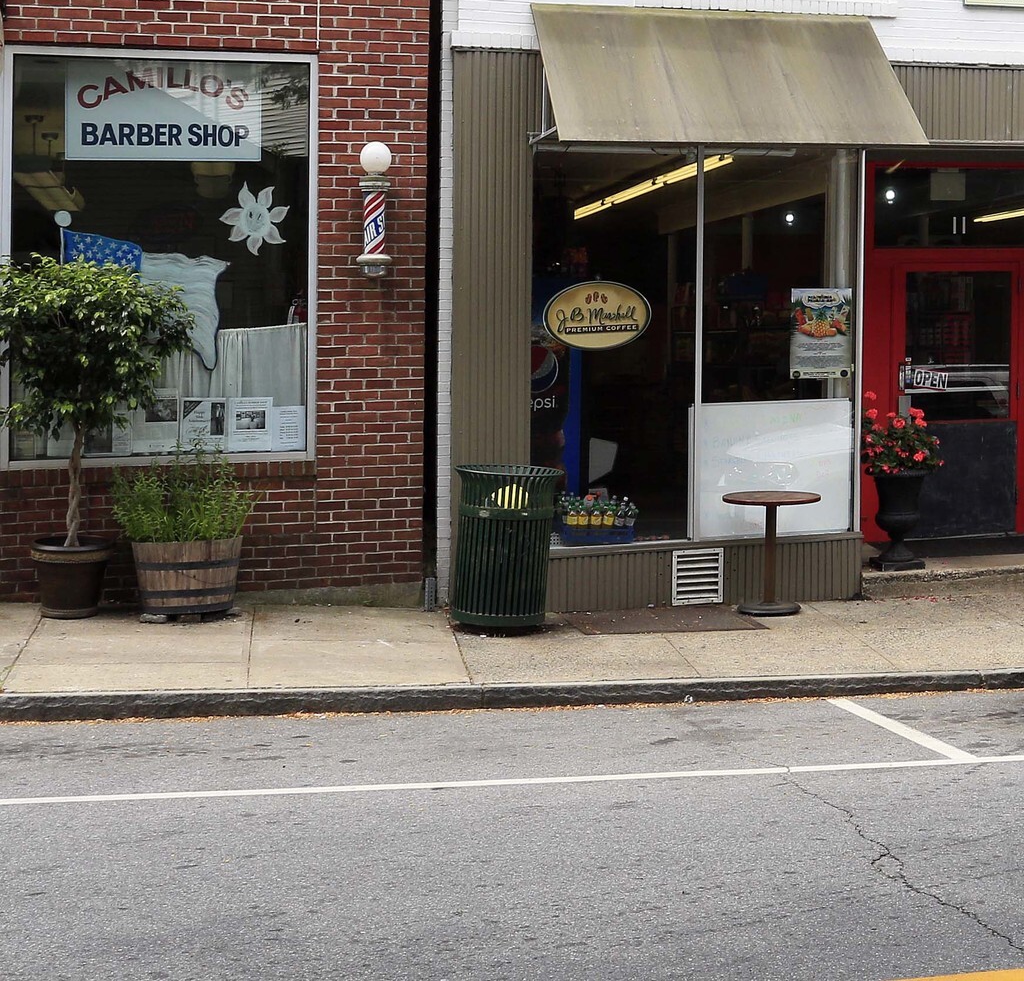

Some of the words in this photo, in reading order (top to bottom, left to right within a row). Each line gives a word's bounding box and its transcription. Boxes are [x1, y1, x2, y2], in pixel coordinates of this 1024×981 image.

[77, 66, 249, 110] CAMILLO'S
[81, 122, 183, 146] BARBER
[187, 123, 249, 147] SHOP
[588, 304, 639, 325] Marshall
[566, 325, 603, 333] PREMIUM
[914, 369, 948, 389] OPEN
